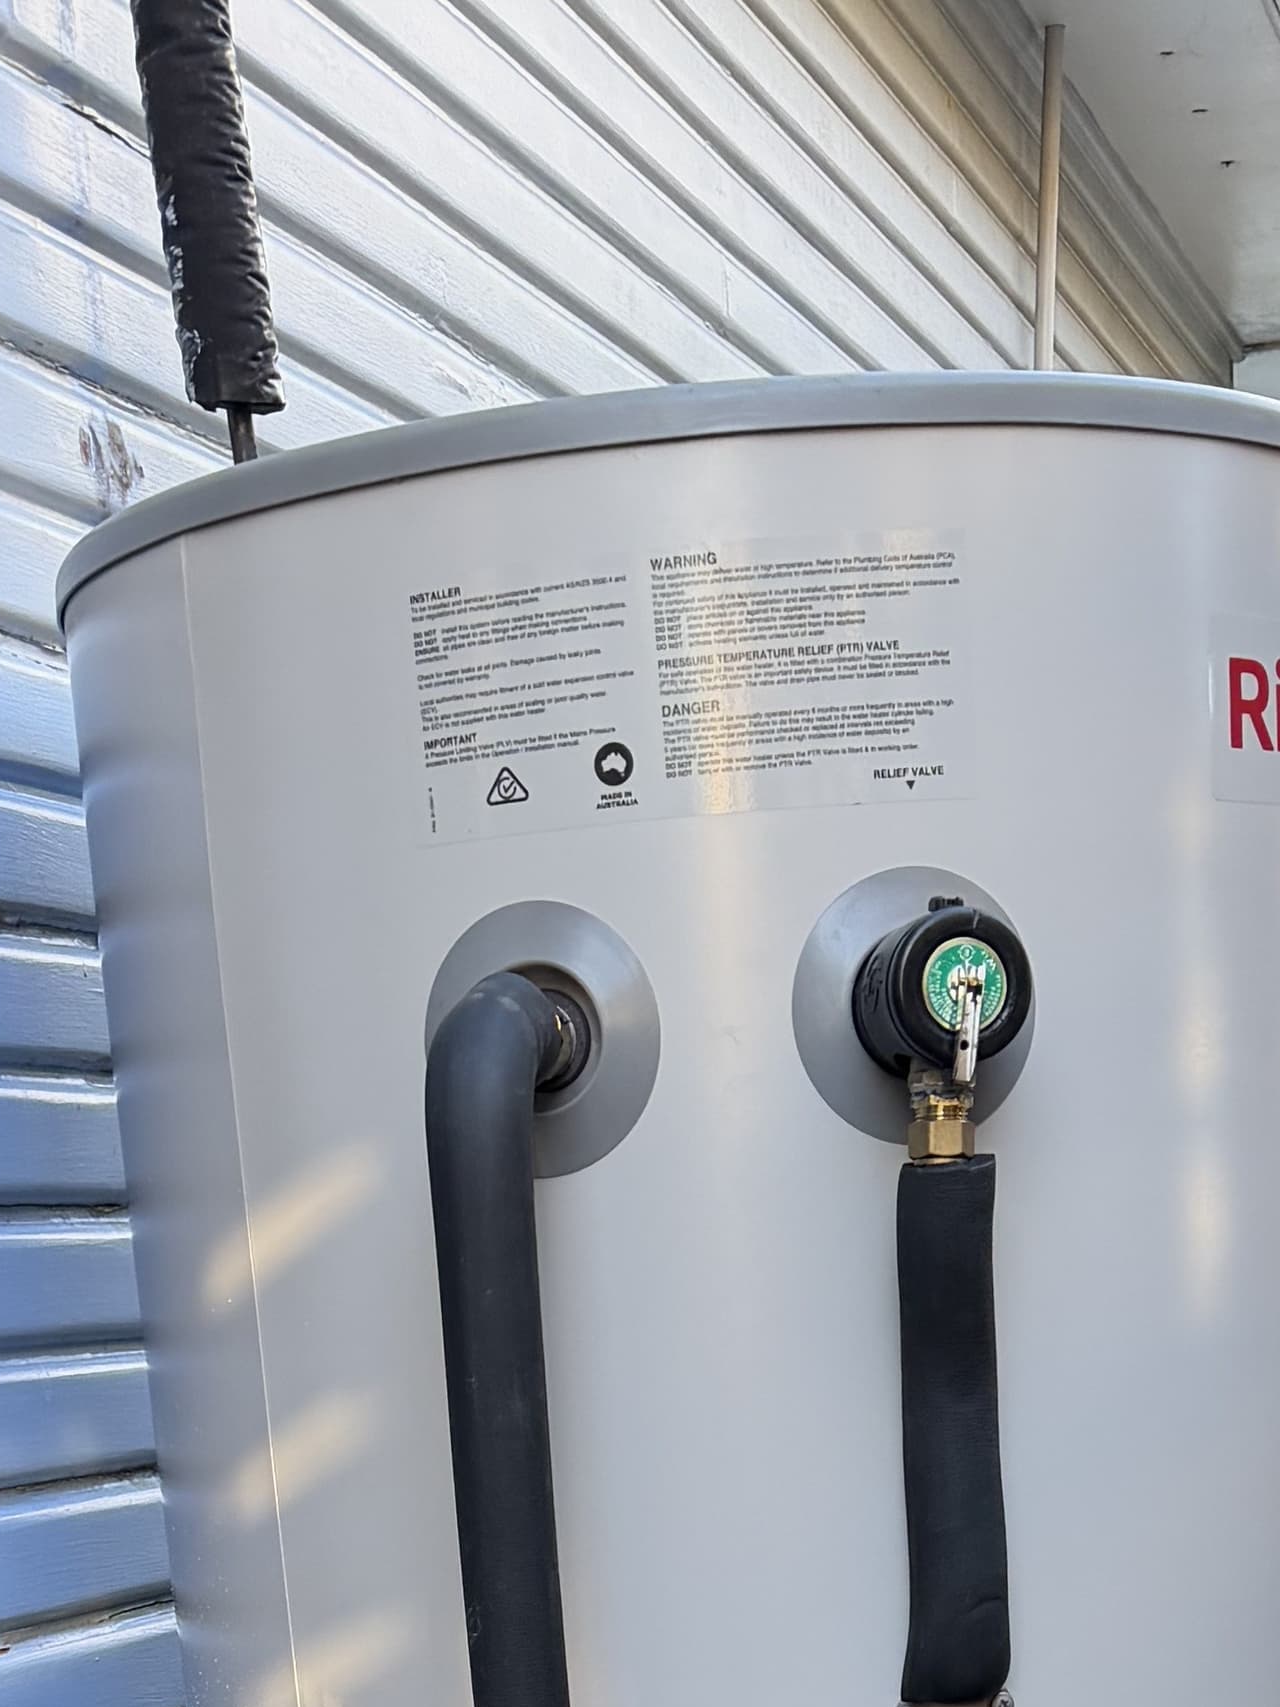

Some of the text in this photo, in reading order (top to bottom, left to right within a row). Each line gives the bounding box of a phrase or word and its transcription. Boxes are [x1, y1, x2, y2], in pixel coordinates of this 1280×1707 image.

[649, 552, 717, 571] WARNING
[409, 587, 460, 604] INSTALLER
[658, 640, 899, 669] PRESSURE TEMPERATURE RELIEF (PTR) VALVE
[661, 699, 720, 717] DANGER
[424, 732, 476, 750] IMPORTANT
[873, 764, 945, 780] RELIEF VALVE
[595, 797, 639, 810] AUSTRALIA
